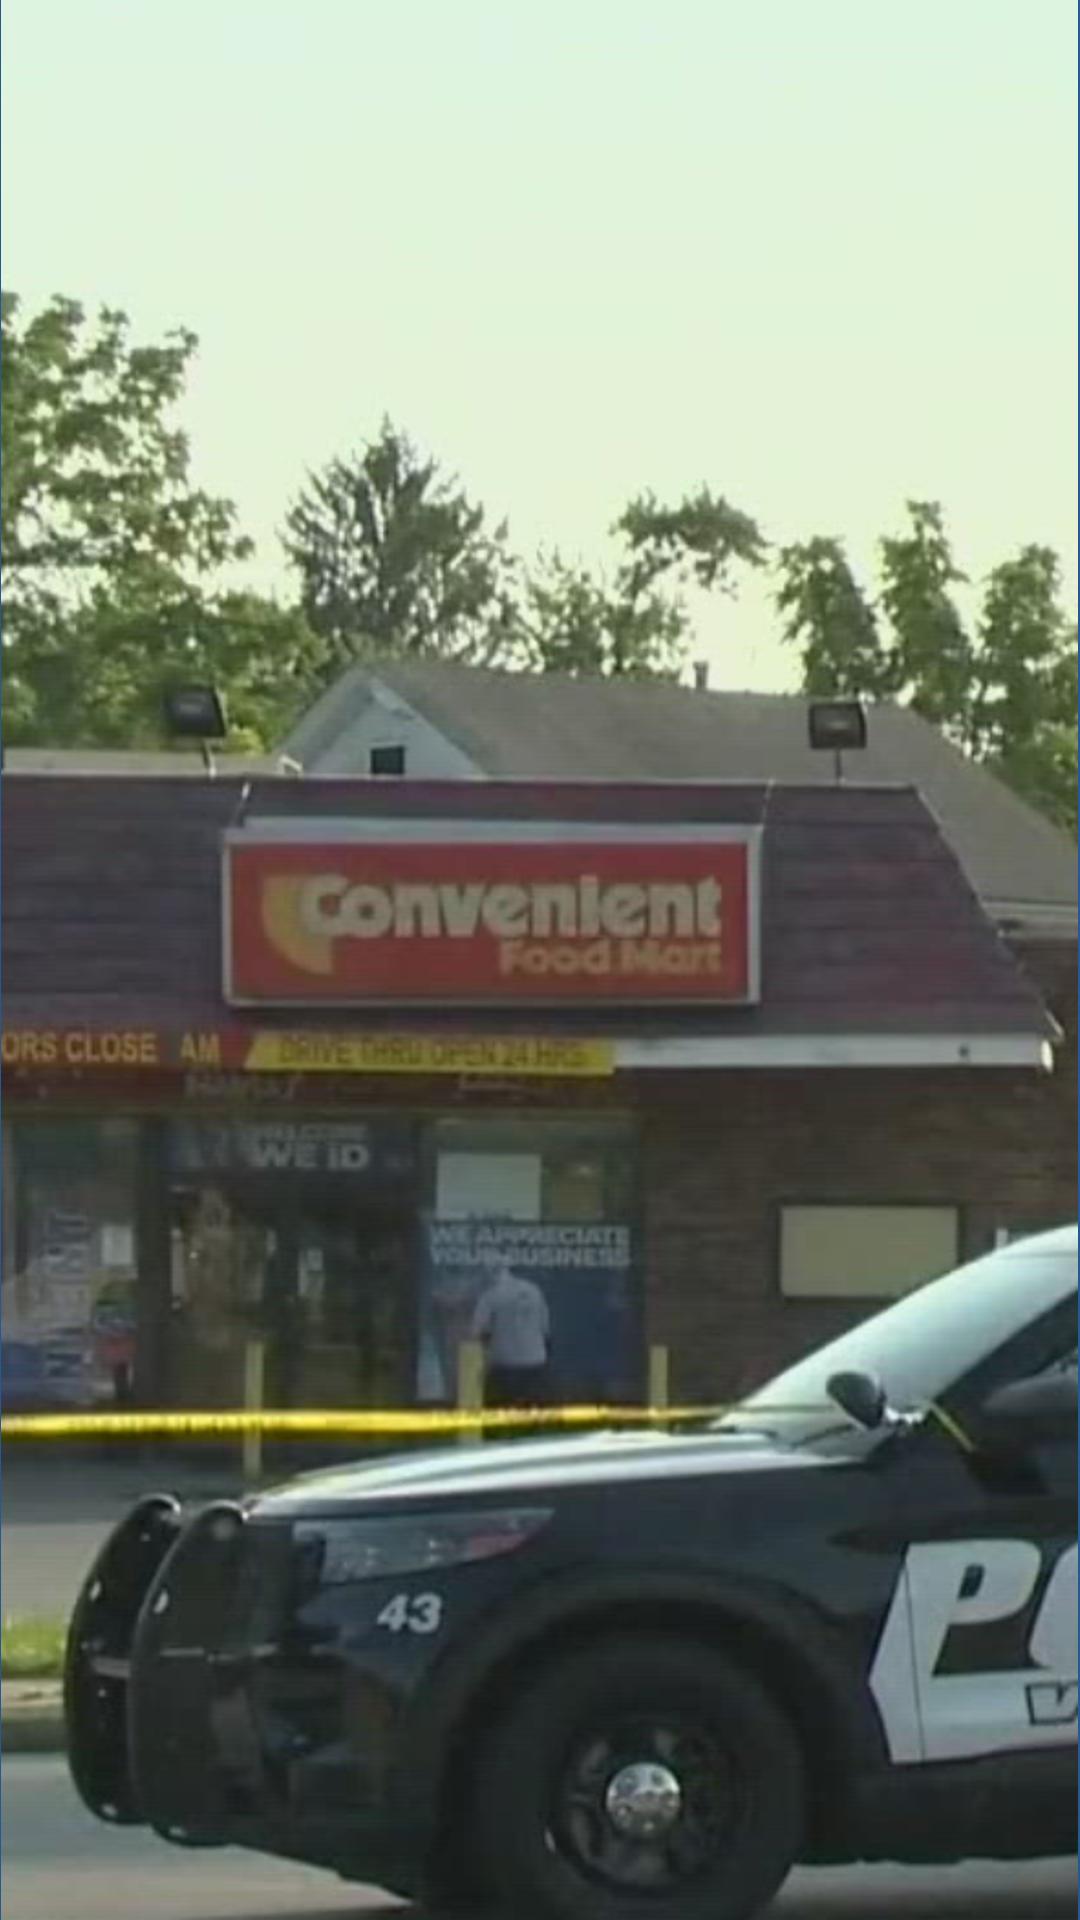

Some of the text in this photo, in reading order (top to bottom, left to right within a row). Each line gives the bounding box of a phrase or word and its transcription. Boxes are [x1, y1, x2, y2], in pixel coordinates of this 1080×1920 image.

[301, 873, 722, 939] Convenient
[499, 938, 722, 977] Food Mart
[65, 1032, 157, 1063] CLOSE
[180, 1032, 221, 1064] AM
[279, 1038, 353, 1064] DRIVE
[360, 1039, 424, 1065] THRU
[431, 1040, 497, 1066] OPEN
[502, 1041, 531, 1066] 24
[254, 1142, 370, 1170] WE ID
[430, 1225, 630, 1246] WE APPRECIATE
[502, 1247, 631, 1267] BUSINESS
[376, 1592, 442, 1634] 43
